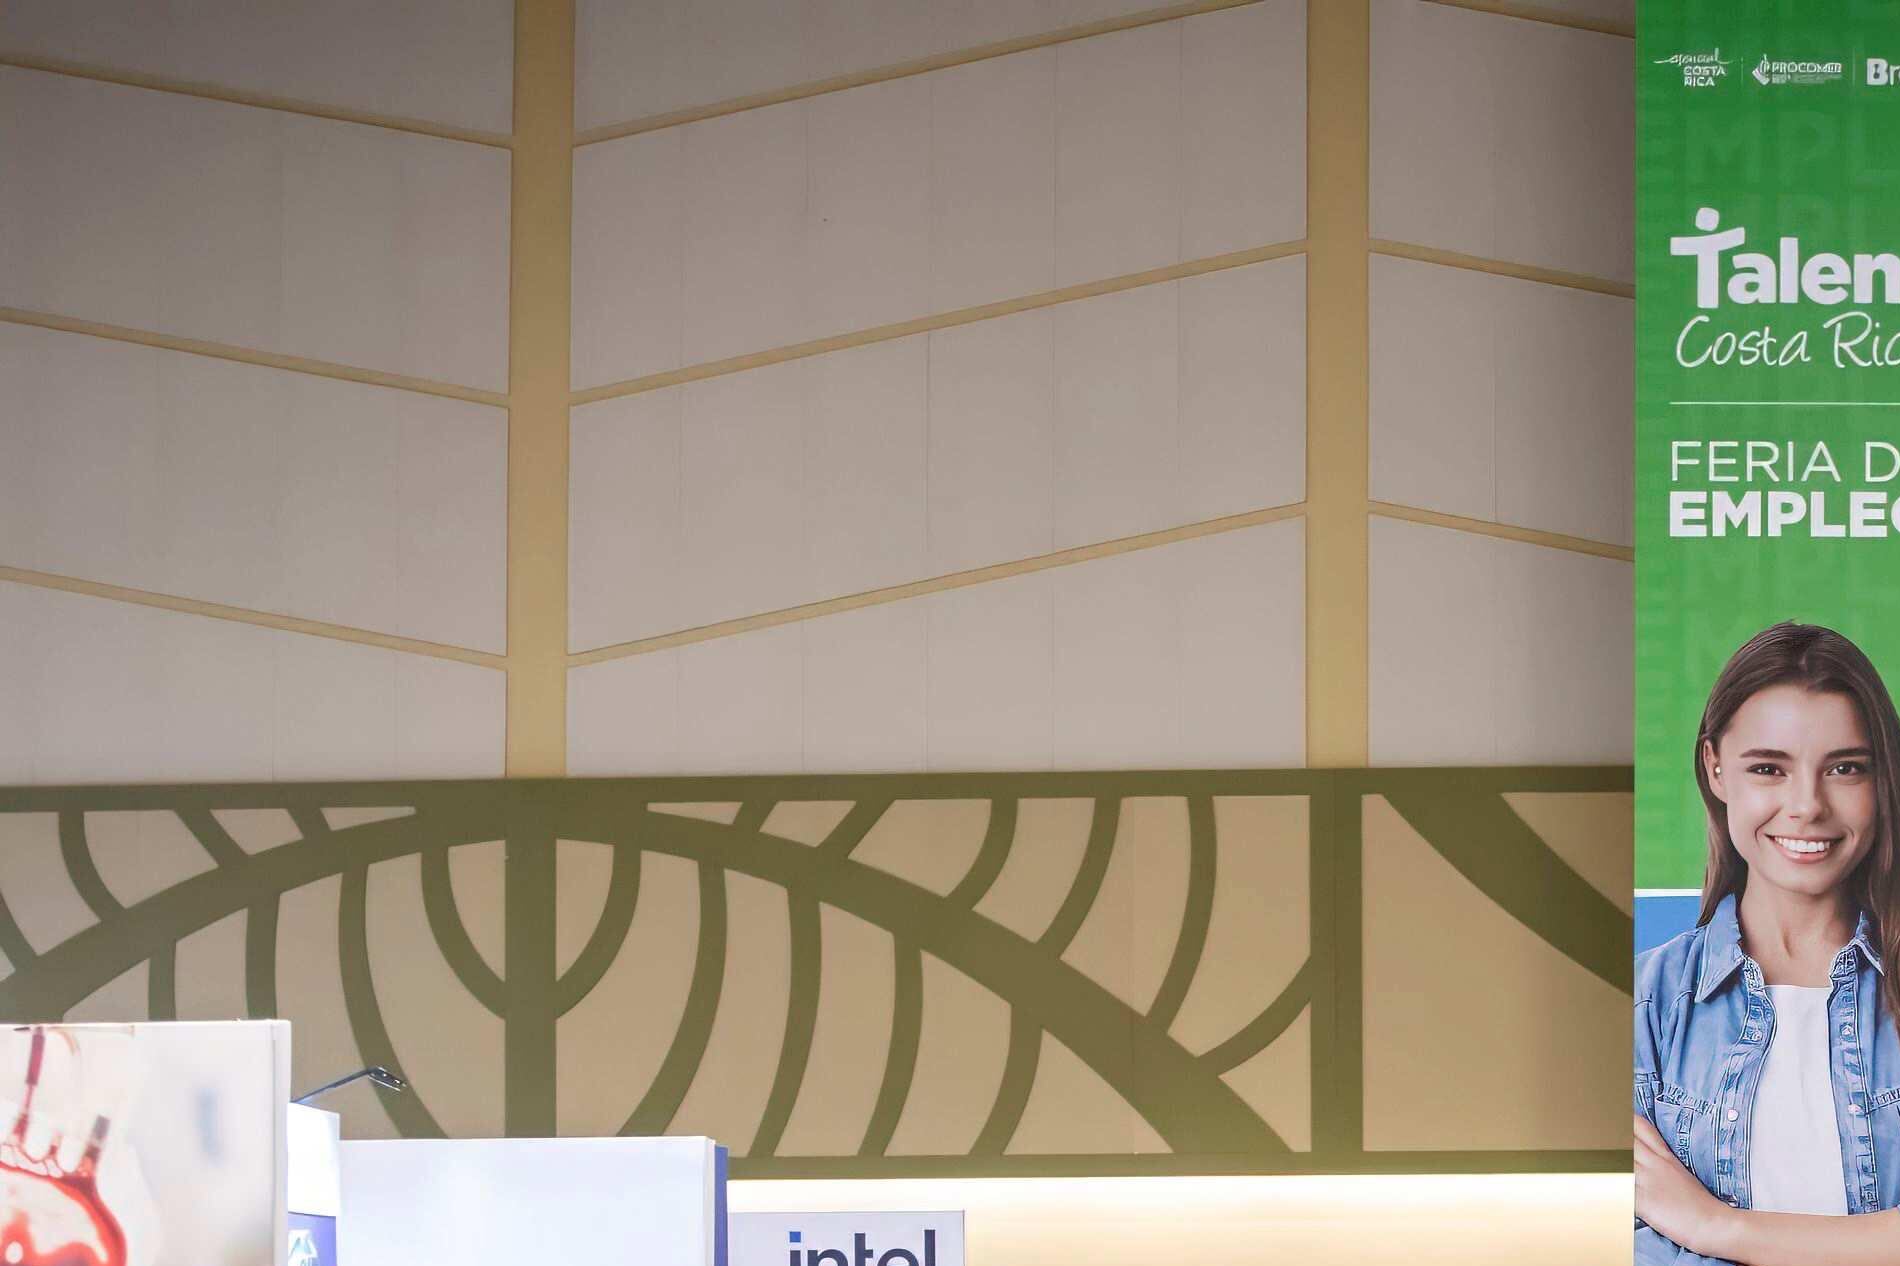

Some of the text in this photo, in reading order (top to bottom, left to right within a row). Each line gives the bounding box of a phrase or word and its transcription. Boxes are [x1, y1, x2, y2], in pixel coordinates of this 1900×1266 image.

[1683, 65, 1727, 77] COSTA
[1684, 76, 1715, 87] RICA
[1675, 314, 1812, 368] Costa
[1671, 440, 1842, 483] FERIA
